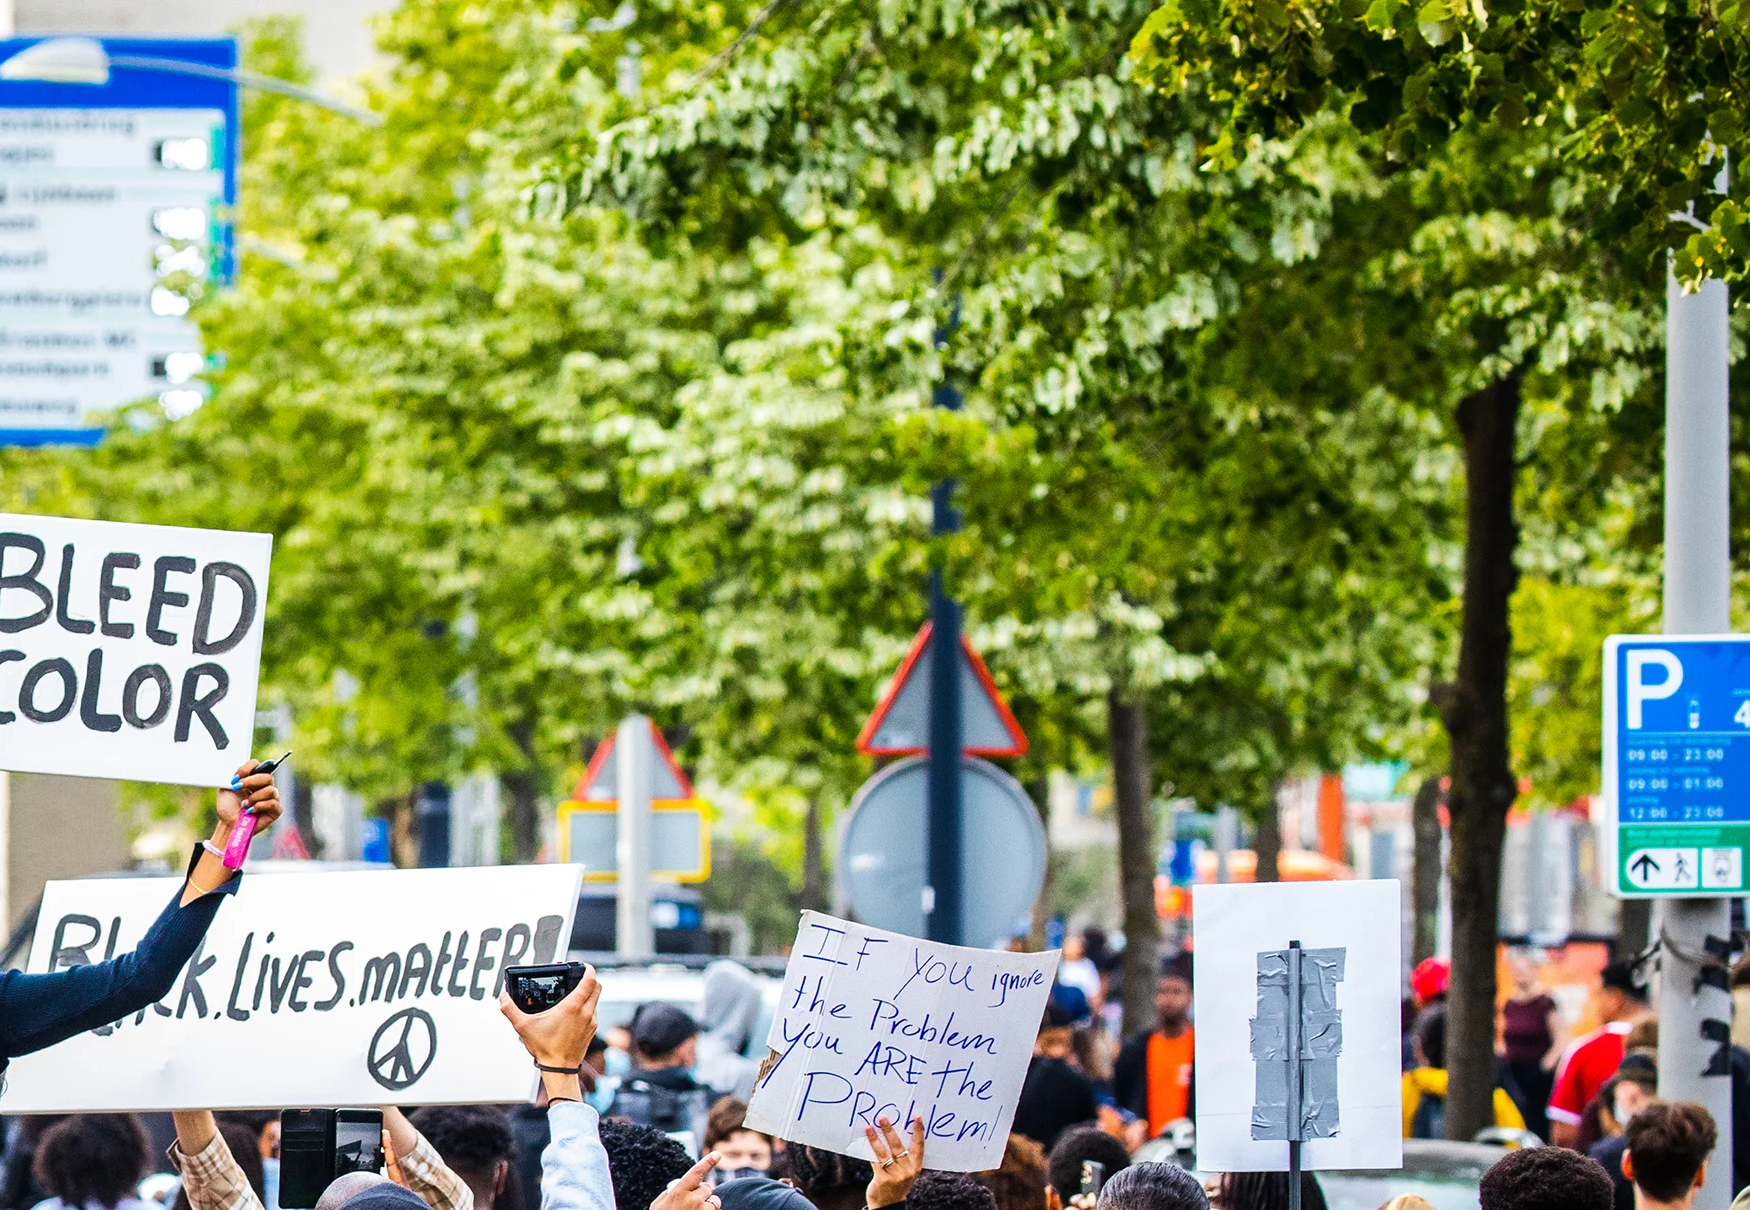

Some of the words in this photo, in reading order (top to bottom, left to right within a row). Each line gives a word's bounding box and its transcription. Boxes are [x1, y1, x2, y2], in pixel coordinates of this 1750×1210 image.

[1626, 649, 1684, 730] P
[792, 976, 852, 1018] the
[870, 998, 997, 1054] Problem
[987, 964, 1045, 1008] ignore
[854, 1041, 927, 1085] ARE
[932, 1060, 993, 1100] the
